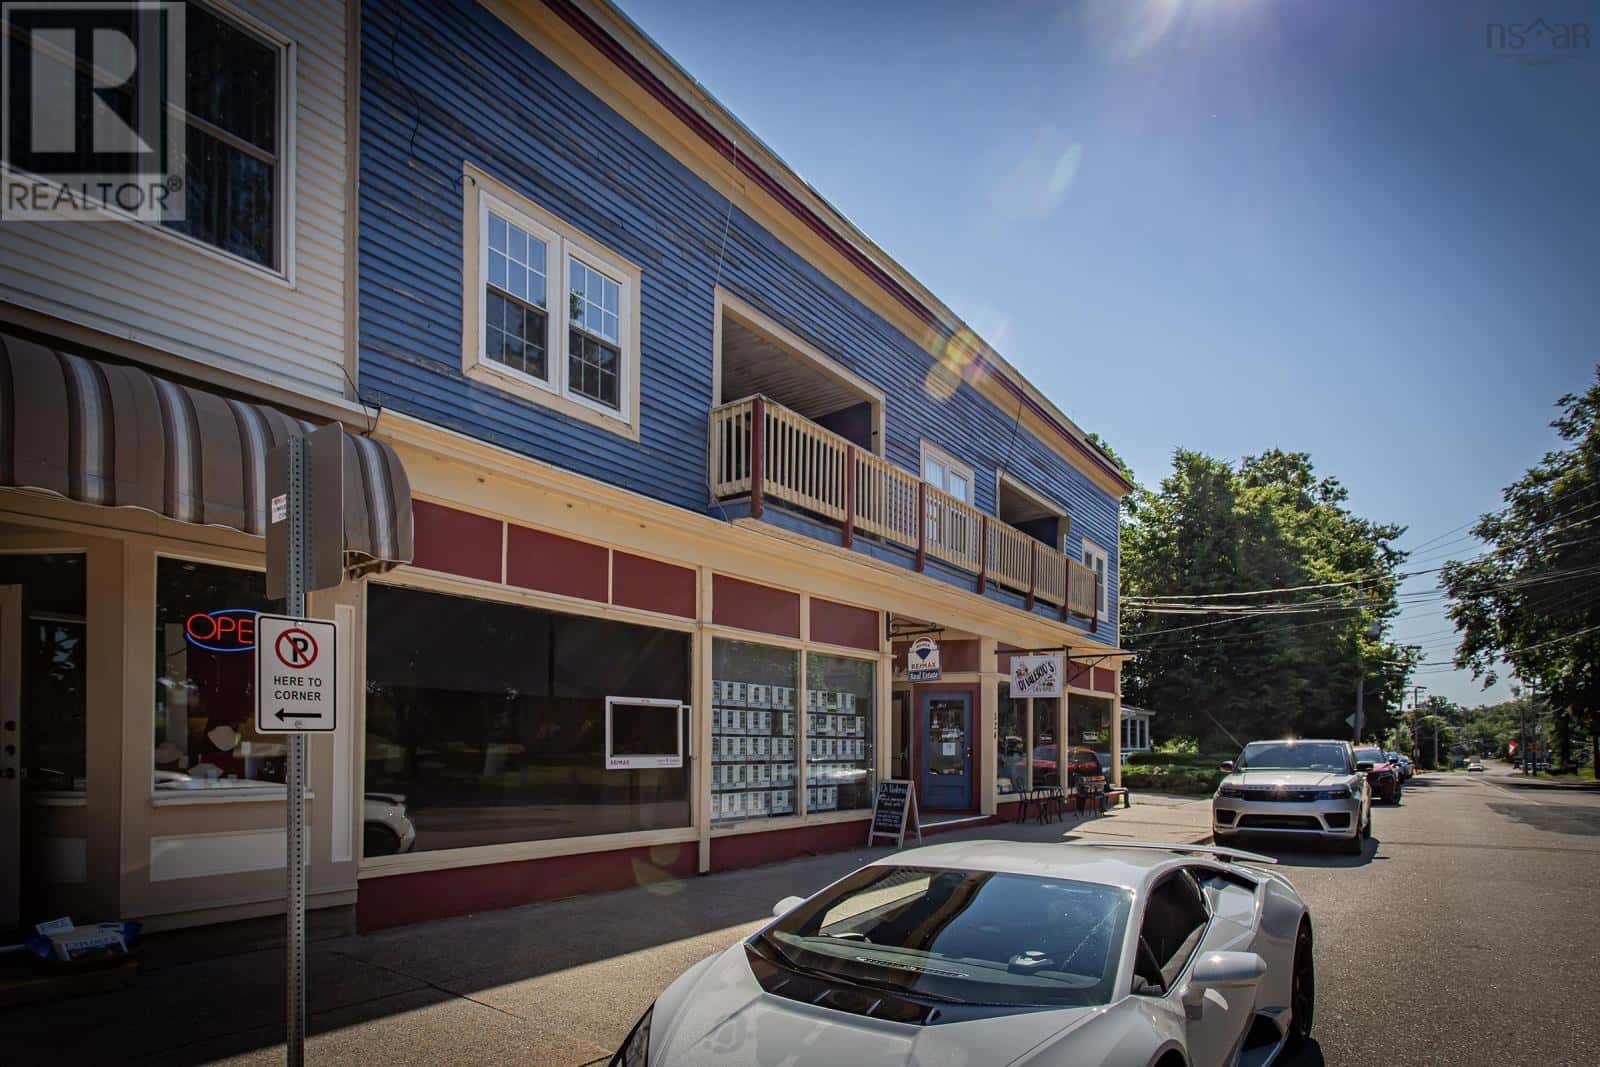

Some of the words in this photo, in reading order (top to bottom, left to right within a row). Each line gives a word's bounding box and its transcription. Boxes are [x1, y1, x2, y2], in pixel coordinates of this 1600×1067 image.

[186, 613, 254, 645] OPE
[273, 675, 304, 687] HERE
[308, 677, 322, 688] TO
[910, 672, 921, 680] Real
[922, 671, 938, 679] Estate
[274, 690, 321, 702] CORNER
